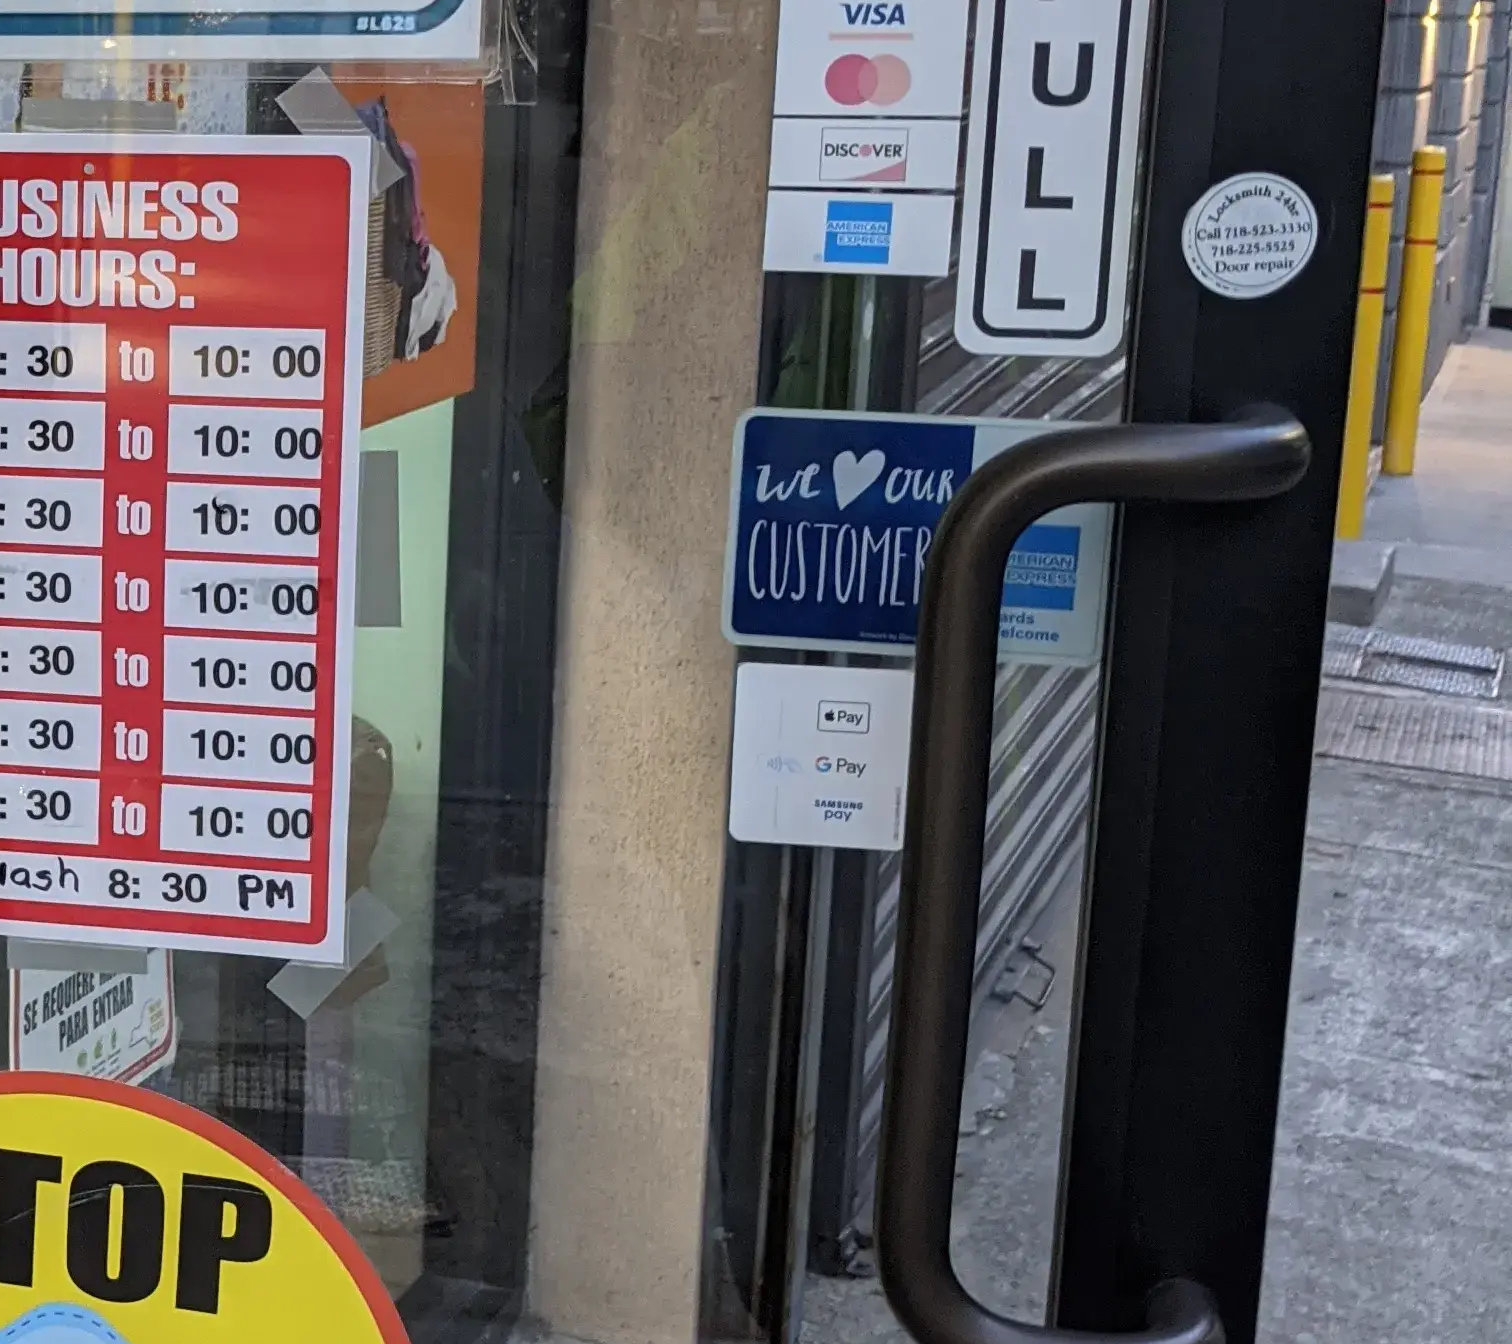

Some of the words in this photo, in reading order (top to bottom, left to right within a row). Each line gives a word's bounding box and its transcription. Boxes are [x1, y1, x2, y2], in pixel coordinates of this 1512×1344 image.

[840, 2, 906, 26] VISA
[824, 142, 904, 158] DISCOVER
[1207, 184, 1272, 223] Locksmith
[1274, 189, 1300, 218] 24hr
[826, 221, 887, 234] AMERICAN
[1196, 227, 1221, 242] Call
[1215, 260, 1250, 274] Door
[1254, 257, 1295, 273] repair
[118, 340, 155, 383] to
[117, 419, 154, 462] to
[115, 493, 152, 536] to
[748, 519, 932, 607] CUSTOMER
[1007, 553, 1074, 569] ERICAN
[114, 570, 150, 613] to
[1000, 611, 1035, 625] ards
[1000, 625, 1060, 642] elcome
[113, 646, 150, 688] to
[837, 710, 863, 726] Pay
[113, 721, 150, 762] to
[836, 758, 867, 778] Pay
[111, 794, 147, 837] to
[814, 799, 864, 810] SAMSUNG
[824, 810, 853, 822] pay
[237, 874, 295, 911] PM
[23, 998, 38, 1036] SE
[42, 972, 95, 1024] REQUIERE
[59, 1006, 89, 1053] PARA
[92, 975, 134, 1030] ENTRAR
